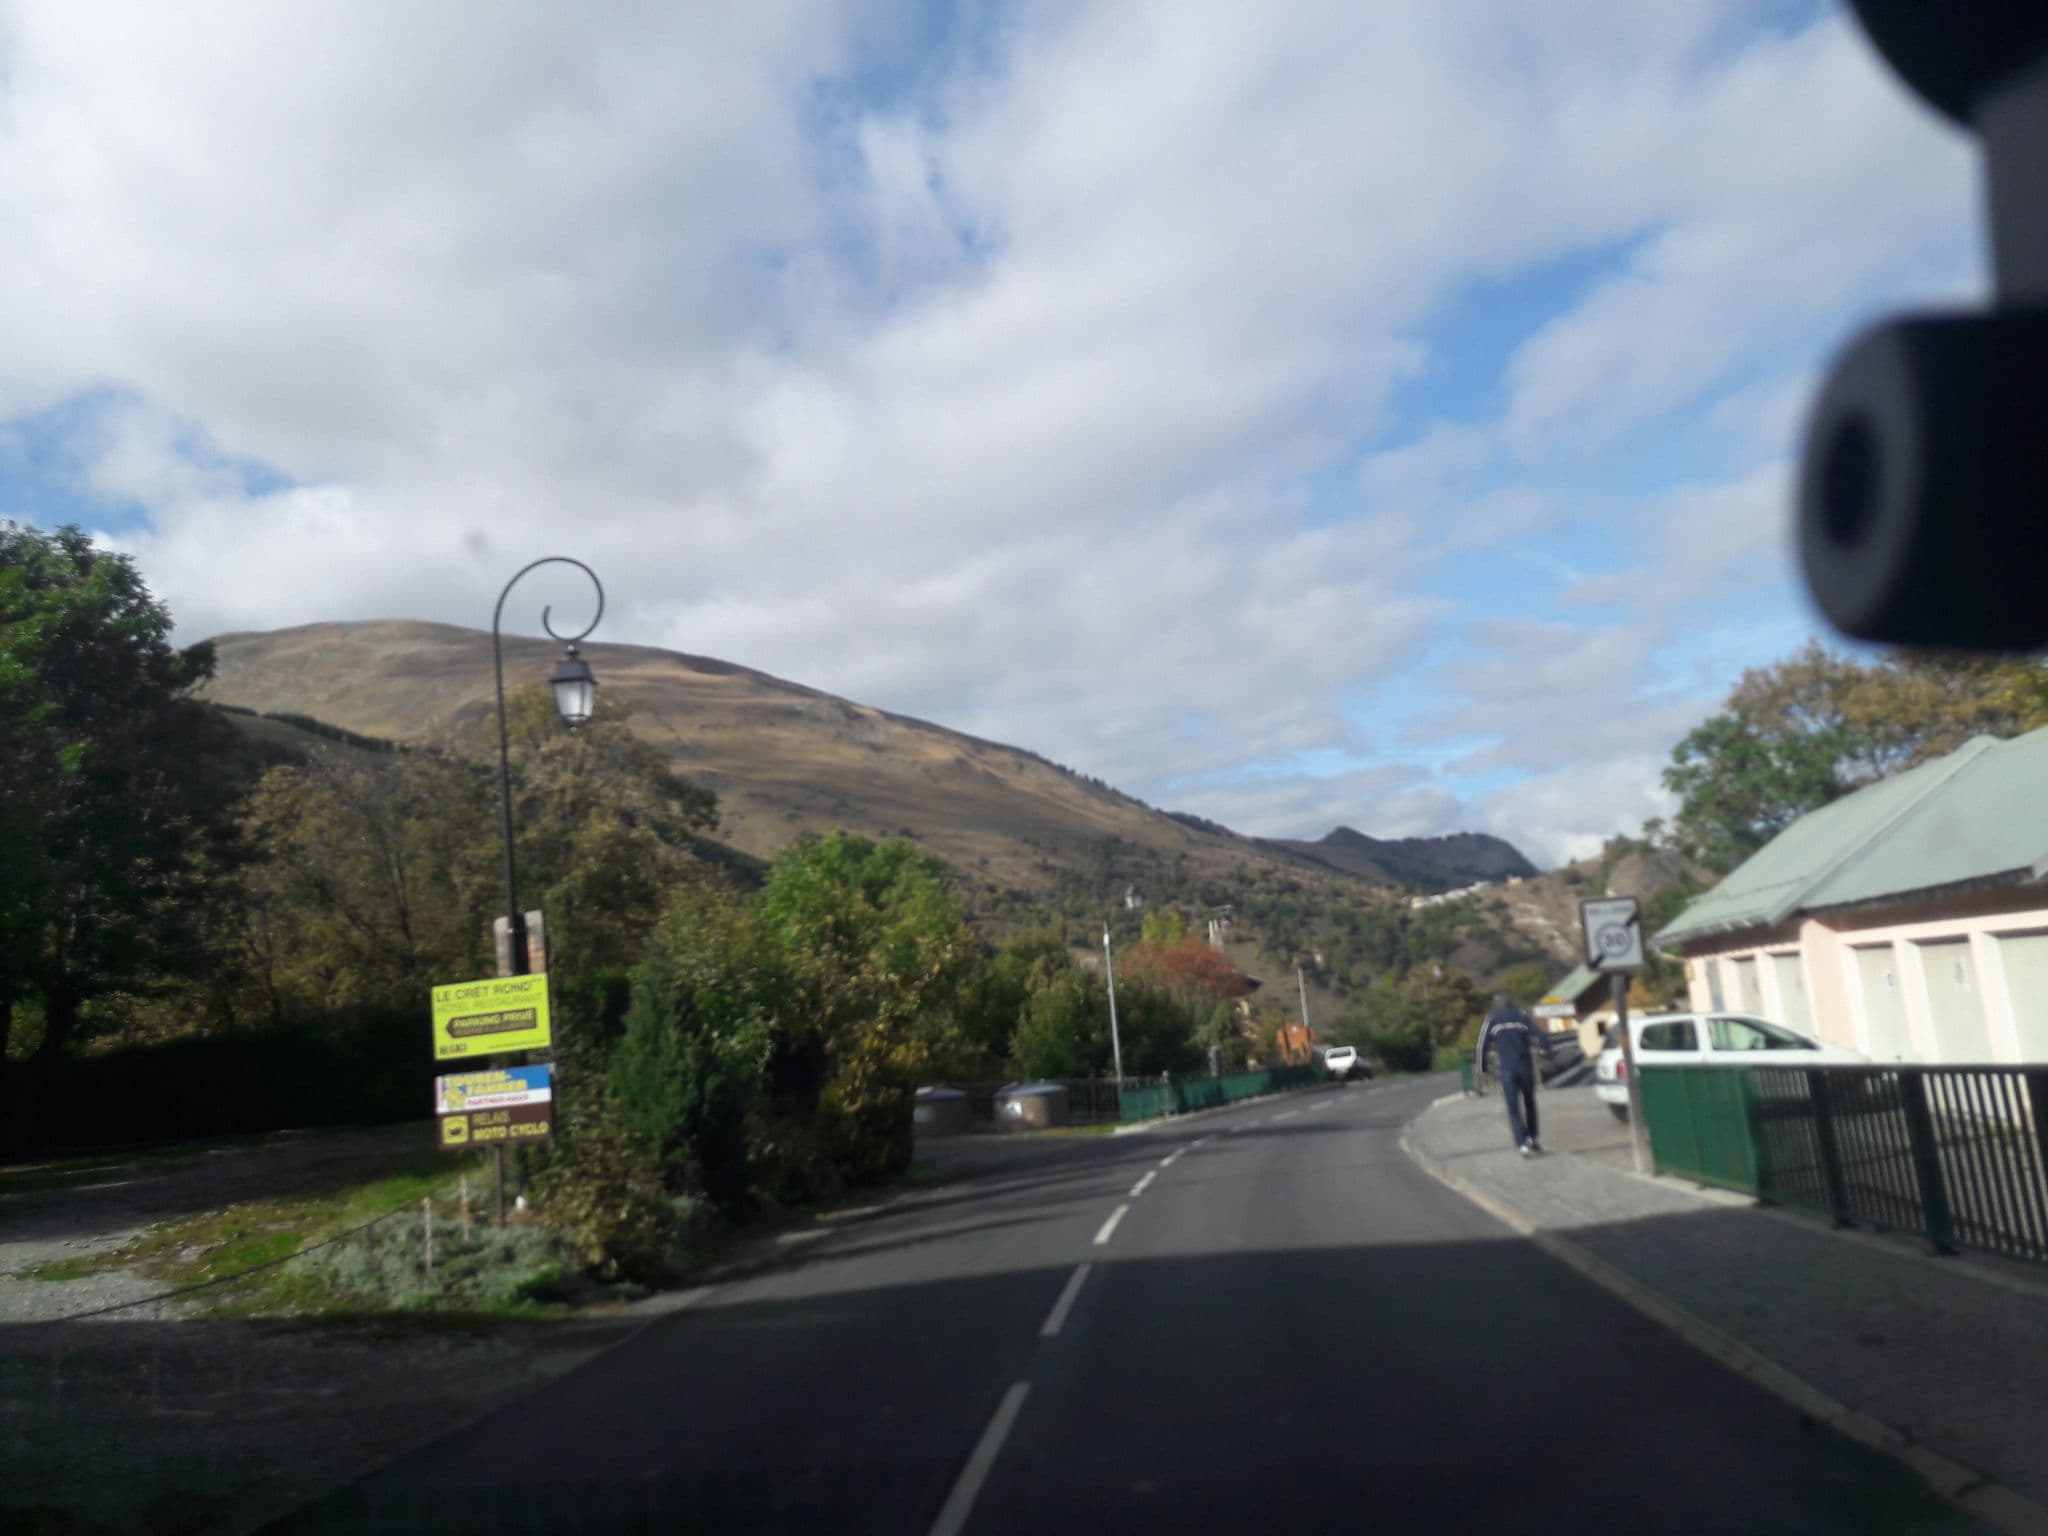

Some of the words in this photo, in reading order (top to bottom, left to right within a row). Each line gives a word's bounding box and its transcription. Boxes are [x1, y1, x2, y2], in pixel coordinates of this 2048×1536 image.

[436, 990, 449, 1002] LE
[473, 1111, 510, 1125] RELAIS
[473, 1126, 507, 1140] MOTO
